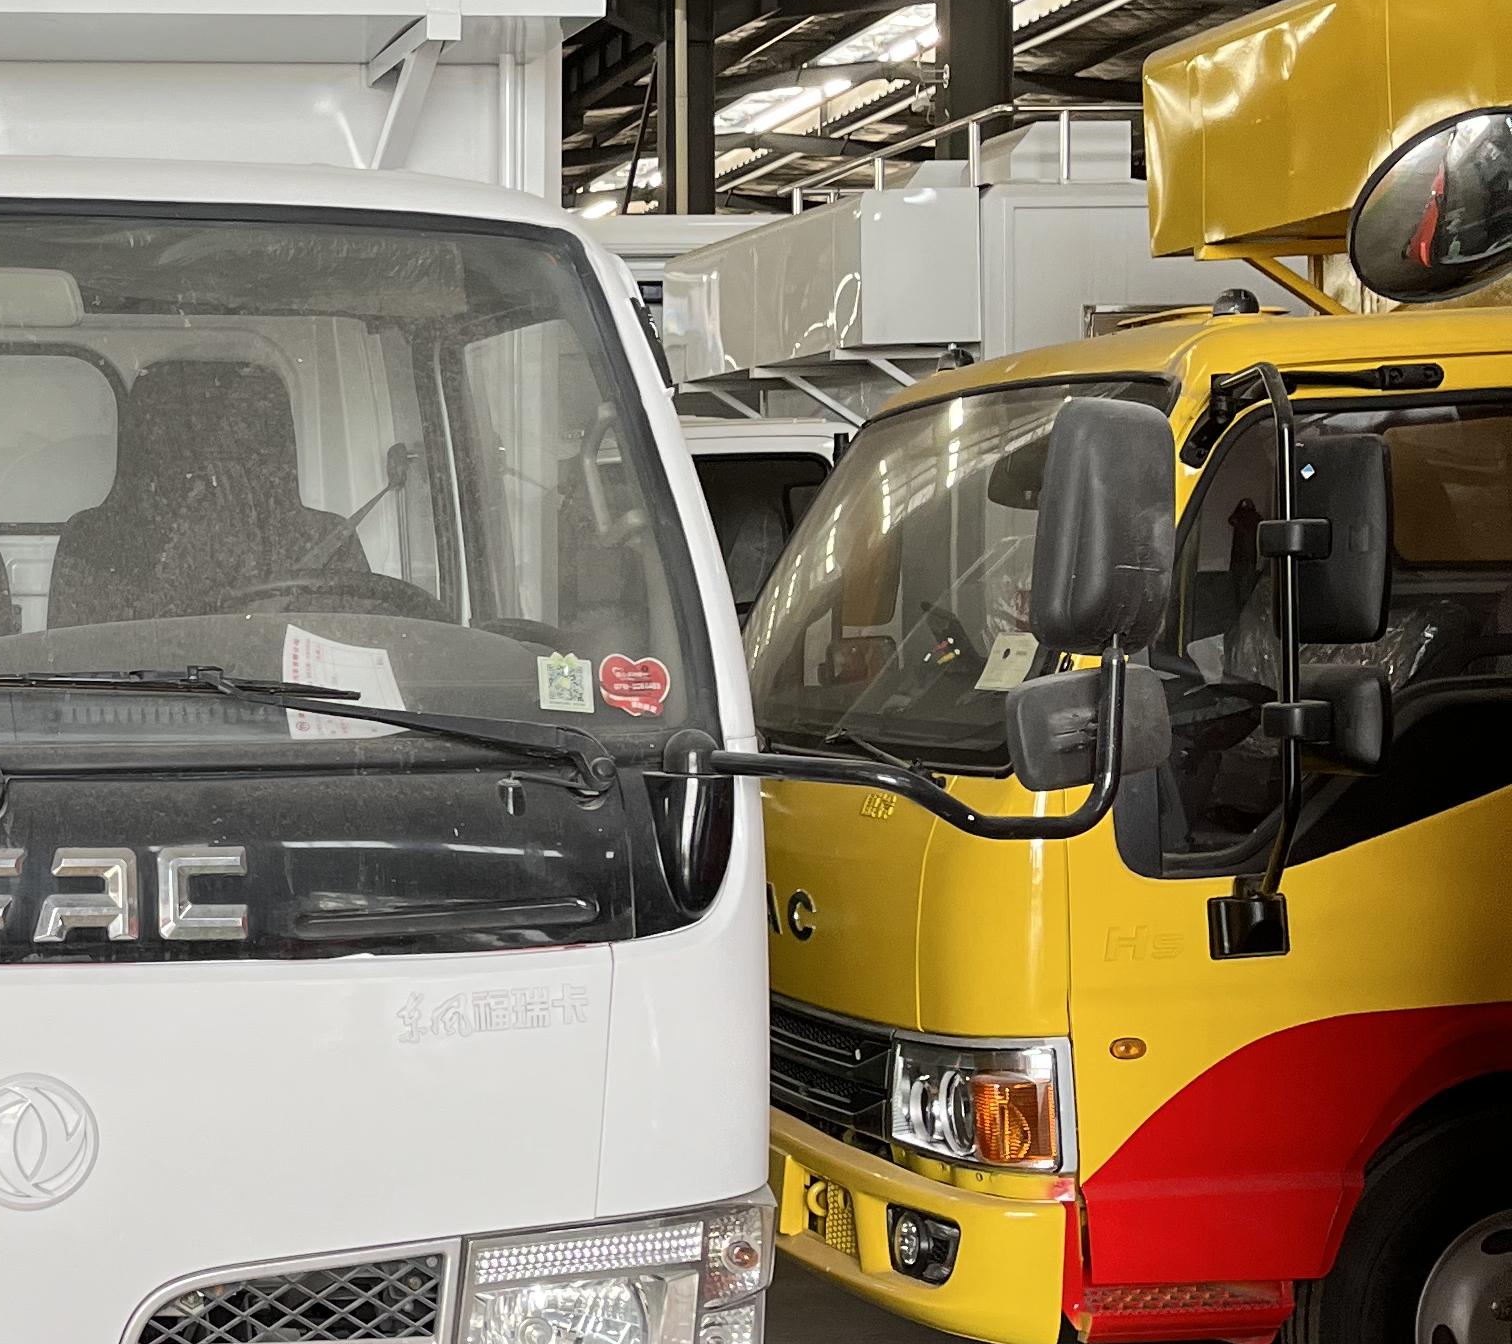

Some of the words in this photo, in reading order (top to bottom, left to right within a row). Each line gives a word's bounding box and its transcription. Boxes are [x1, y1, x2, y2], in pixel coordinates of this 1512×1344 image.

[396, 983, 589, 1044] 东风福瑞卡
